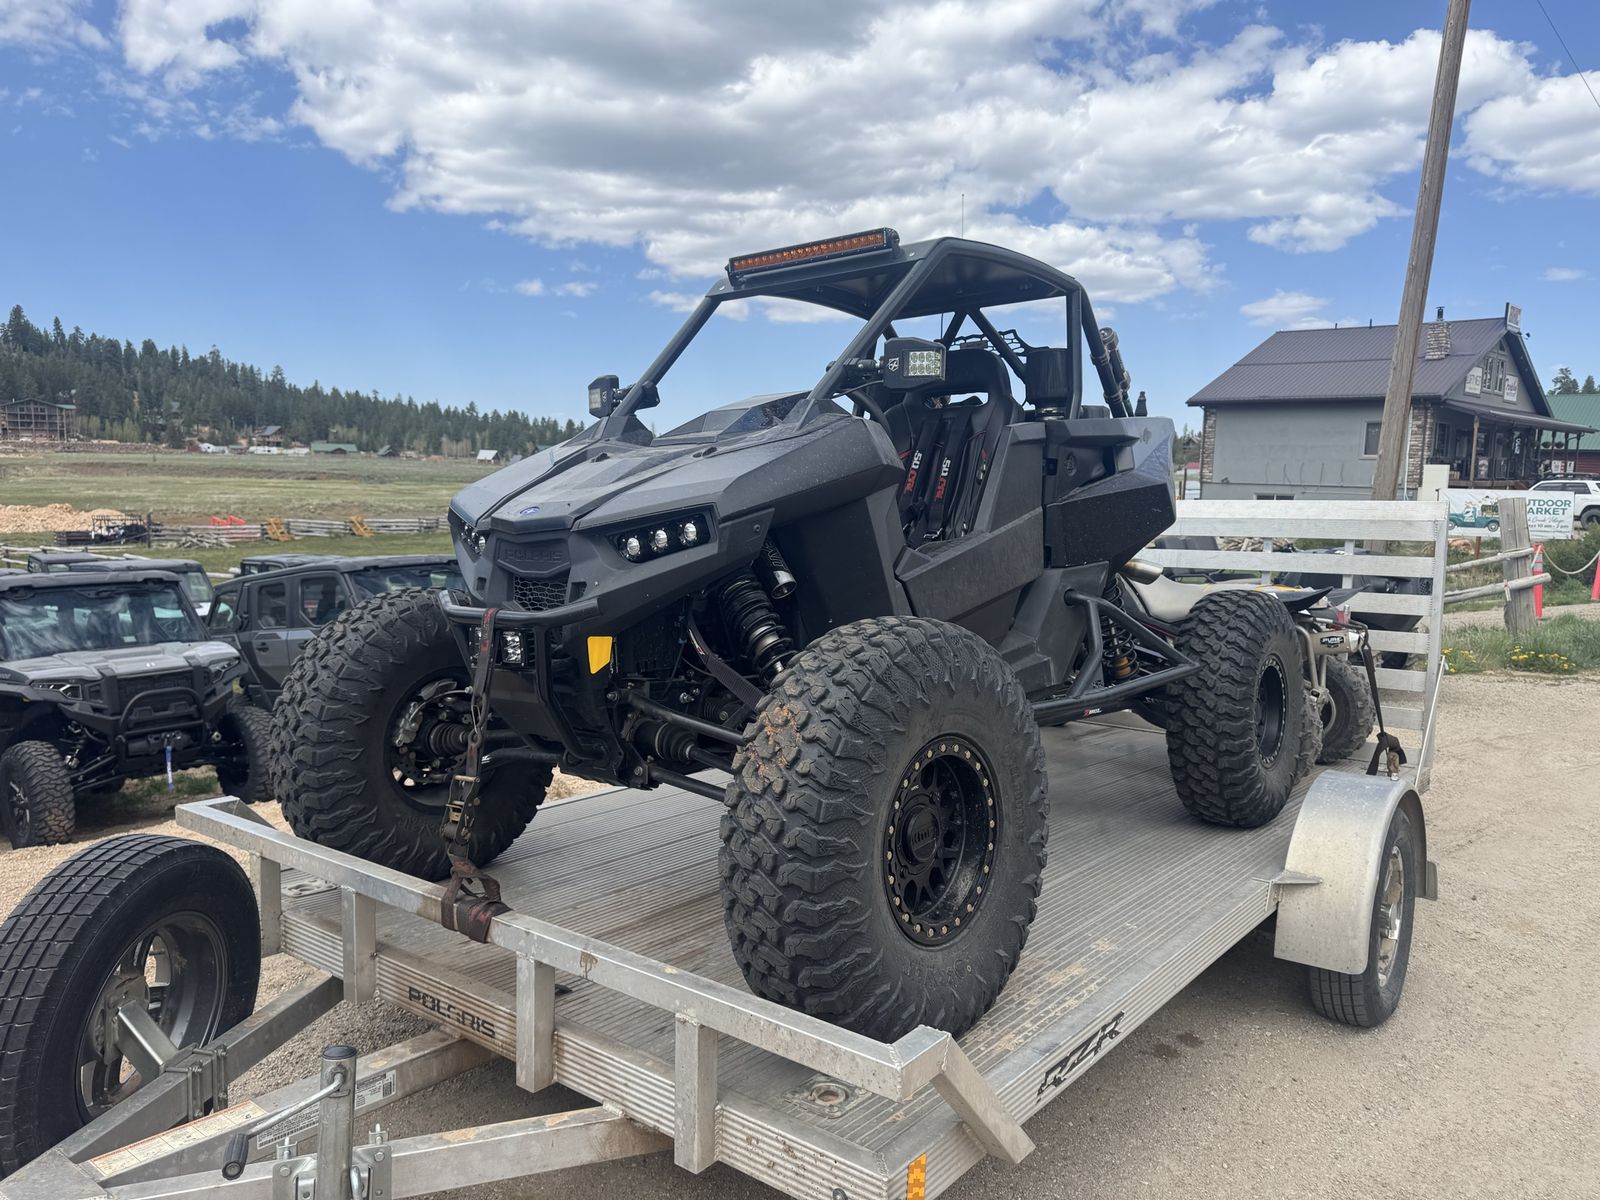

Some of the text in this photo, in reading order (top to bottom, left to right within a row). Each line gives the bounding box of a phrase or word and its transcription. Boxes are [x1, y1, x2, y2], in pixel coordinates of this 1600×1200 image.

[1527, 499, 1572, 507] TDOOR
[1527, 507, 1568, 515] ARKET
[408, 986, 496, 1039] POLARIS
